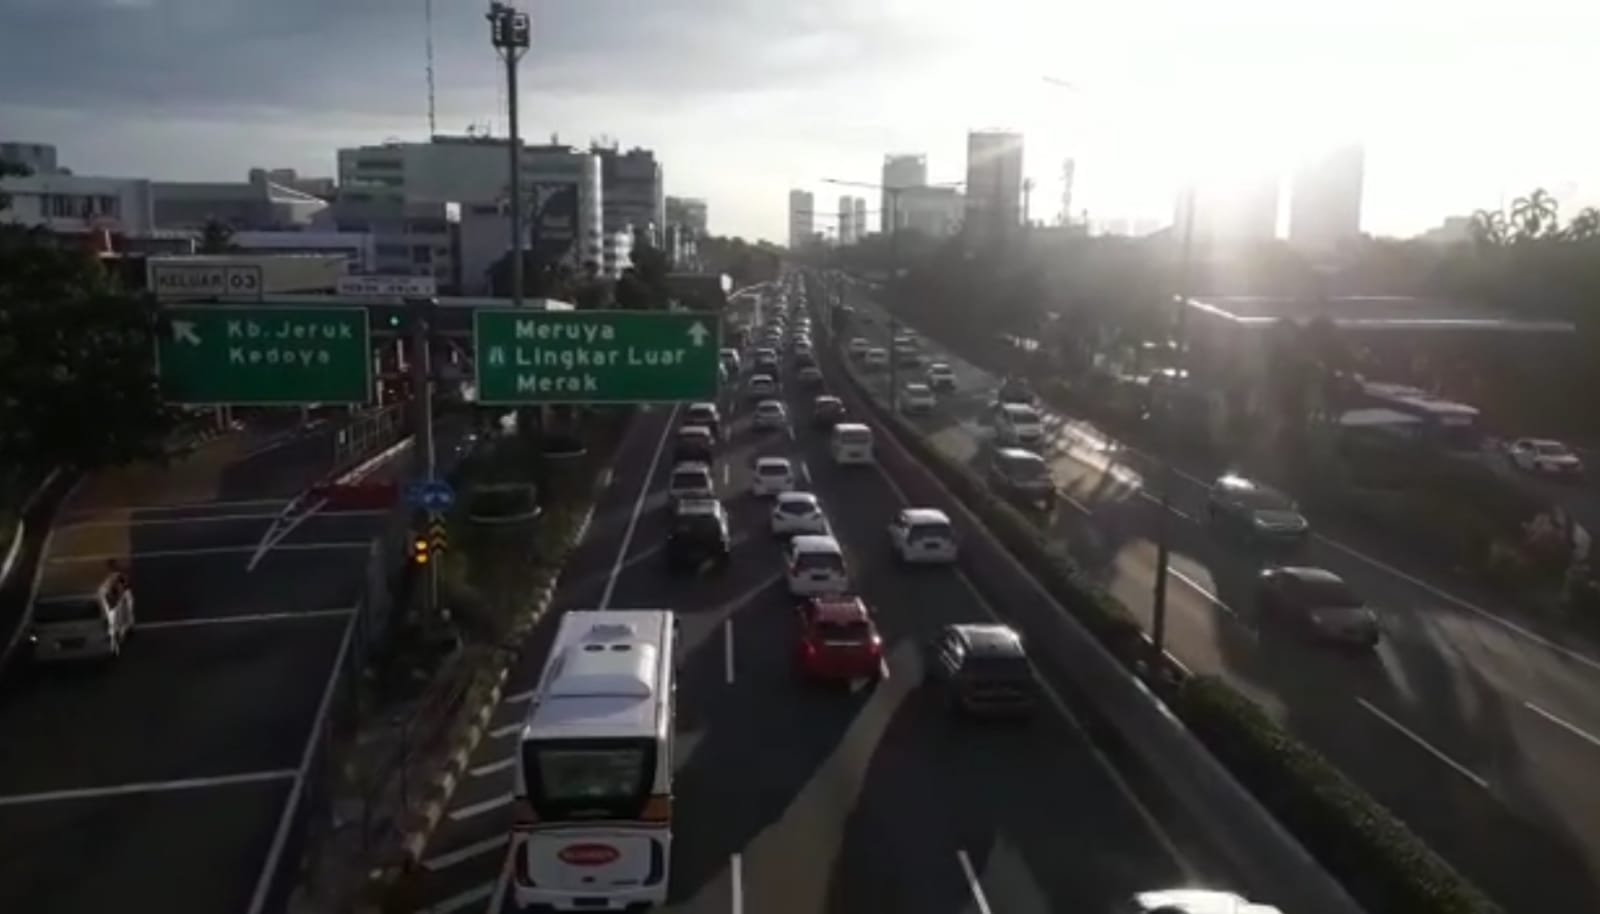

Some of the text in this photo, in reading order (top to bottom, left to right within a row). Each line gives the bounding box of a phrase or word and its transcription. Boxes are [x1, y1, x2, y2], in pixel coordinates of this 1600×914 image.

[230, 274, 256, 289] 03
[516, 319, 616, 343] Meruya
[229, 347, 331, 366] Kedoya
[516, 346, 686, 369] Lingkar Luar
[517, 373, 599, 392] Merak
